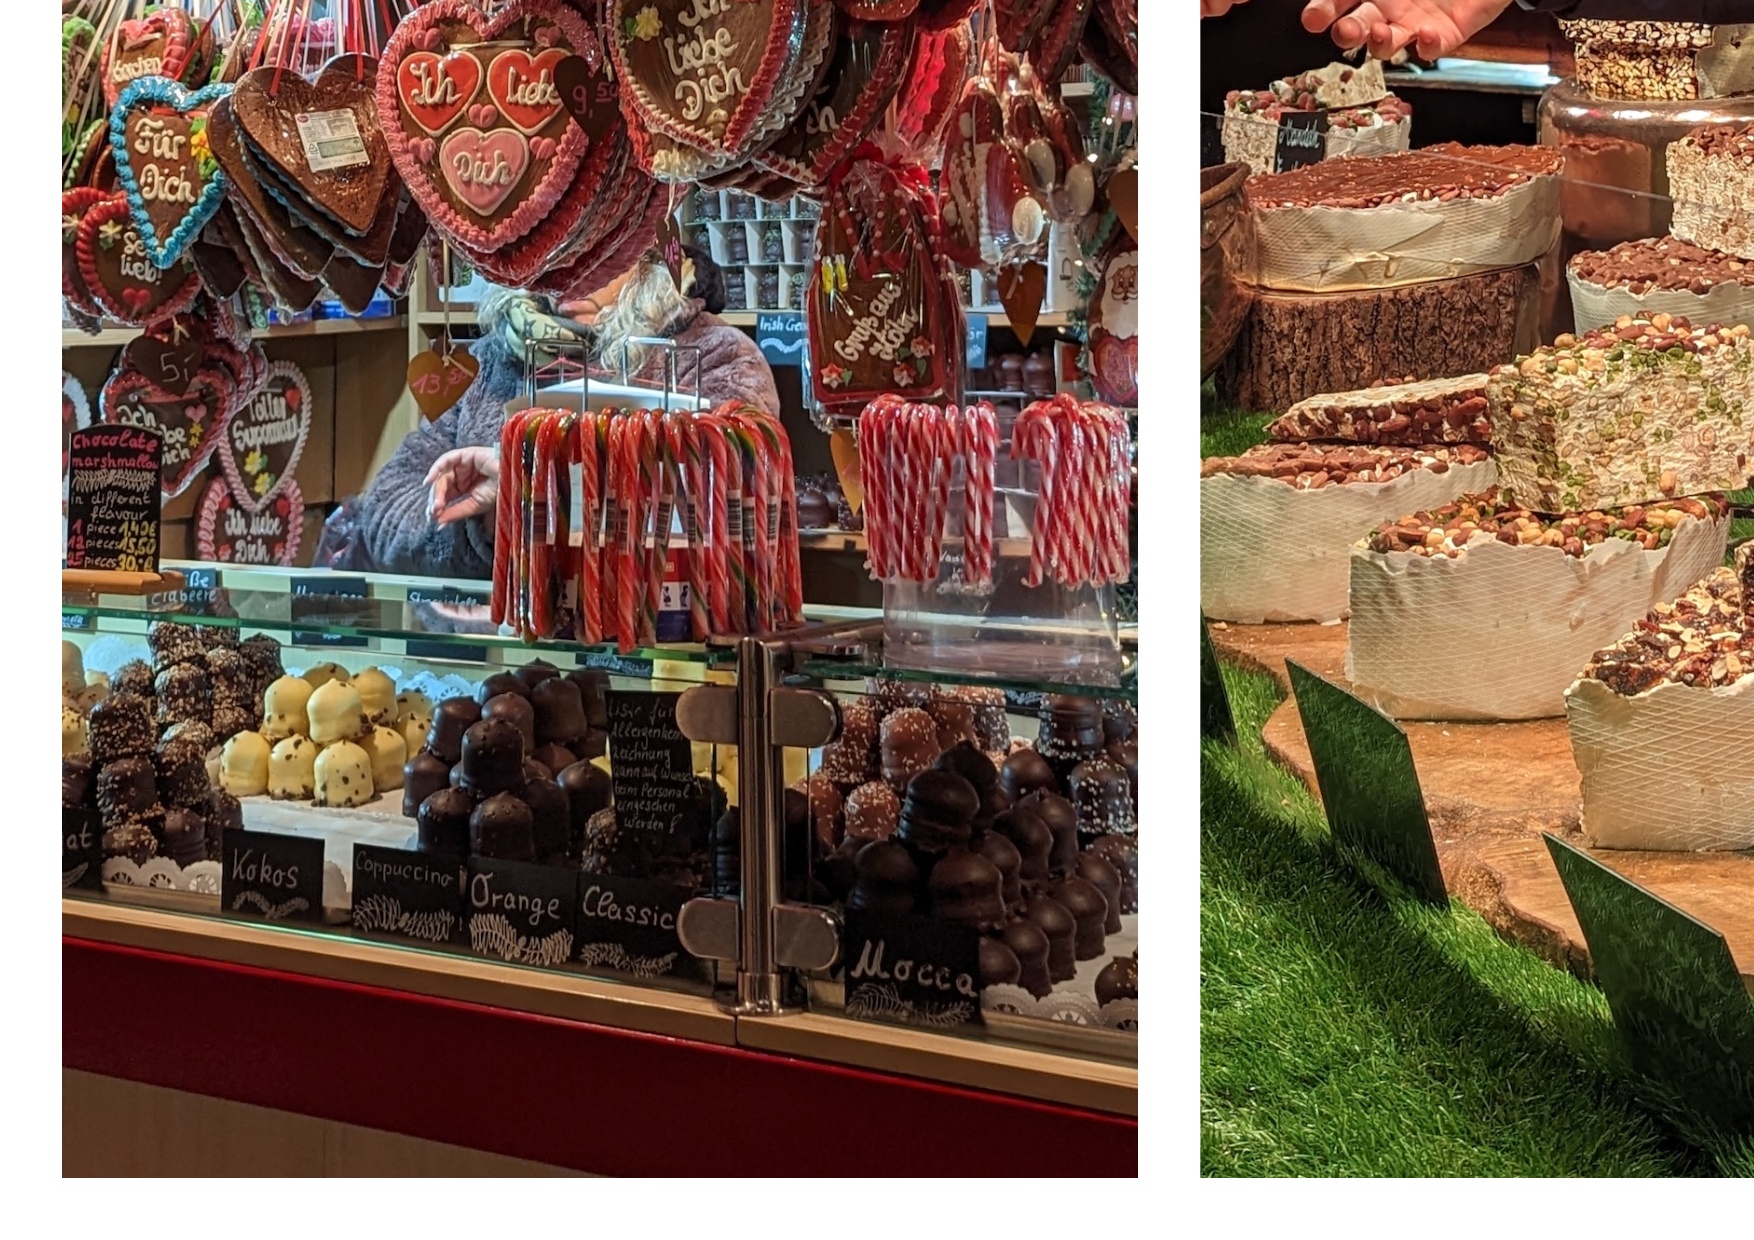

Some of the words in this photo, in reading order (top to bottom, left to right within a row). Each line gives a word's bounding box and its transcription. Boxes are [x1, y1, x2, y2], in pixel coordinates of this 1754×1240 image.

[410, 61, 463, 105] Ich
[675, 61, 751, 121] Dich
[134, 118, 186, 160] Für
[453, 149, 515, 185] Dich
[140, 163, 196, 203] Dich
[760, 315, 784, 331] Irish
[73, 430, 158, 452] Chocolate
[72, 453, 160, 470] marshmallow
[162, 447, 190, 466] ich
[71, 492, 84, 505] in
[91, 490, 150, 508] different
[72, 519, 83, 534] 1
[86, 521, 116, 536] piece
[90, 508, 149, 523] flavour
[68, 536, 86, 550] 12
[86, 539, 119, 553] pieces
[235, 535, 270, 563] Dich
[84, 554, 118, 569] pieces
[641, 783, 690, 799] Personal
[233, 849, 299, 890] Kokos
[471, 872, 561, 926] Orange
[582, 886, 676, 930] Classic
[851, 941, 979, 997] Mocca
